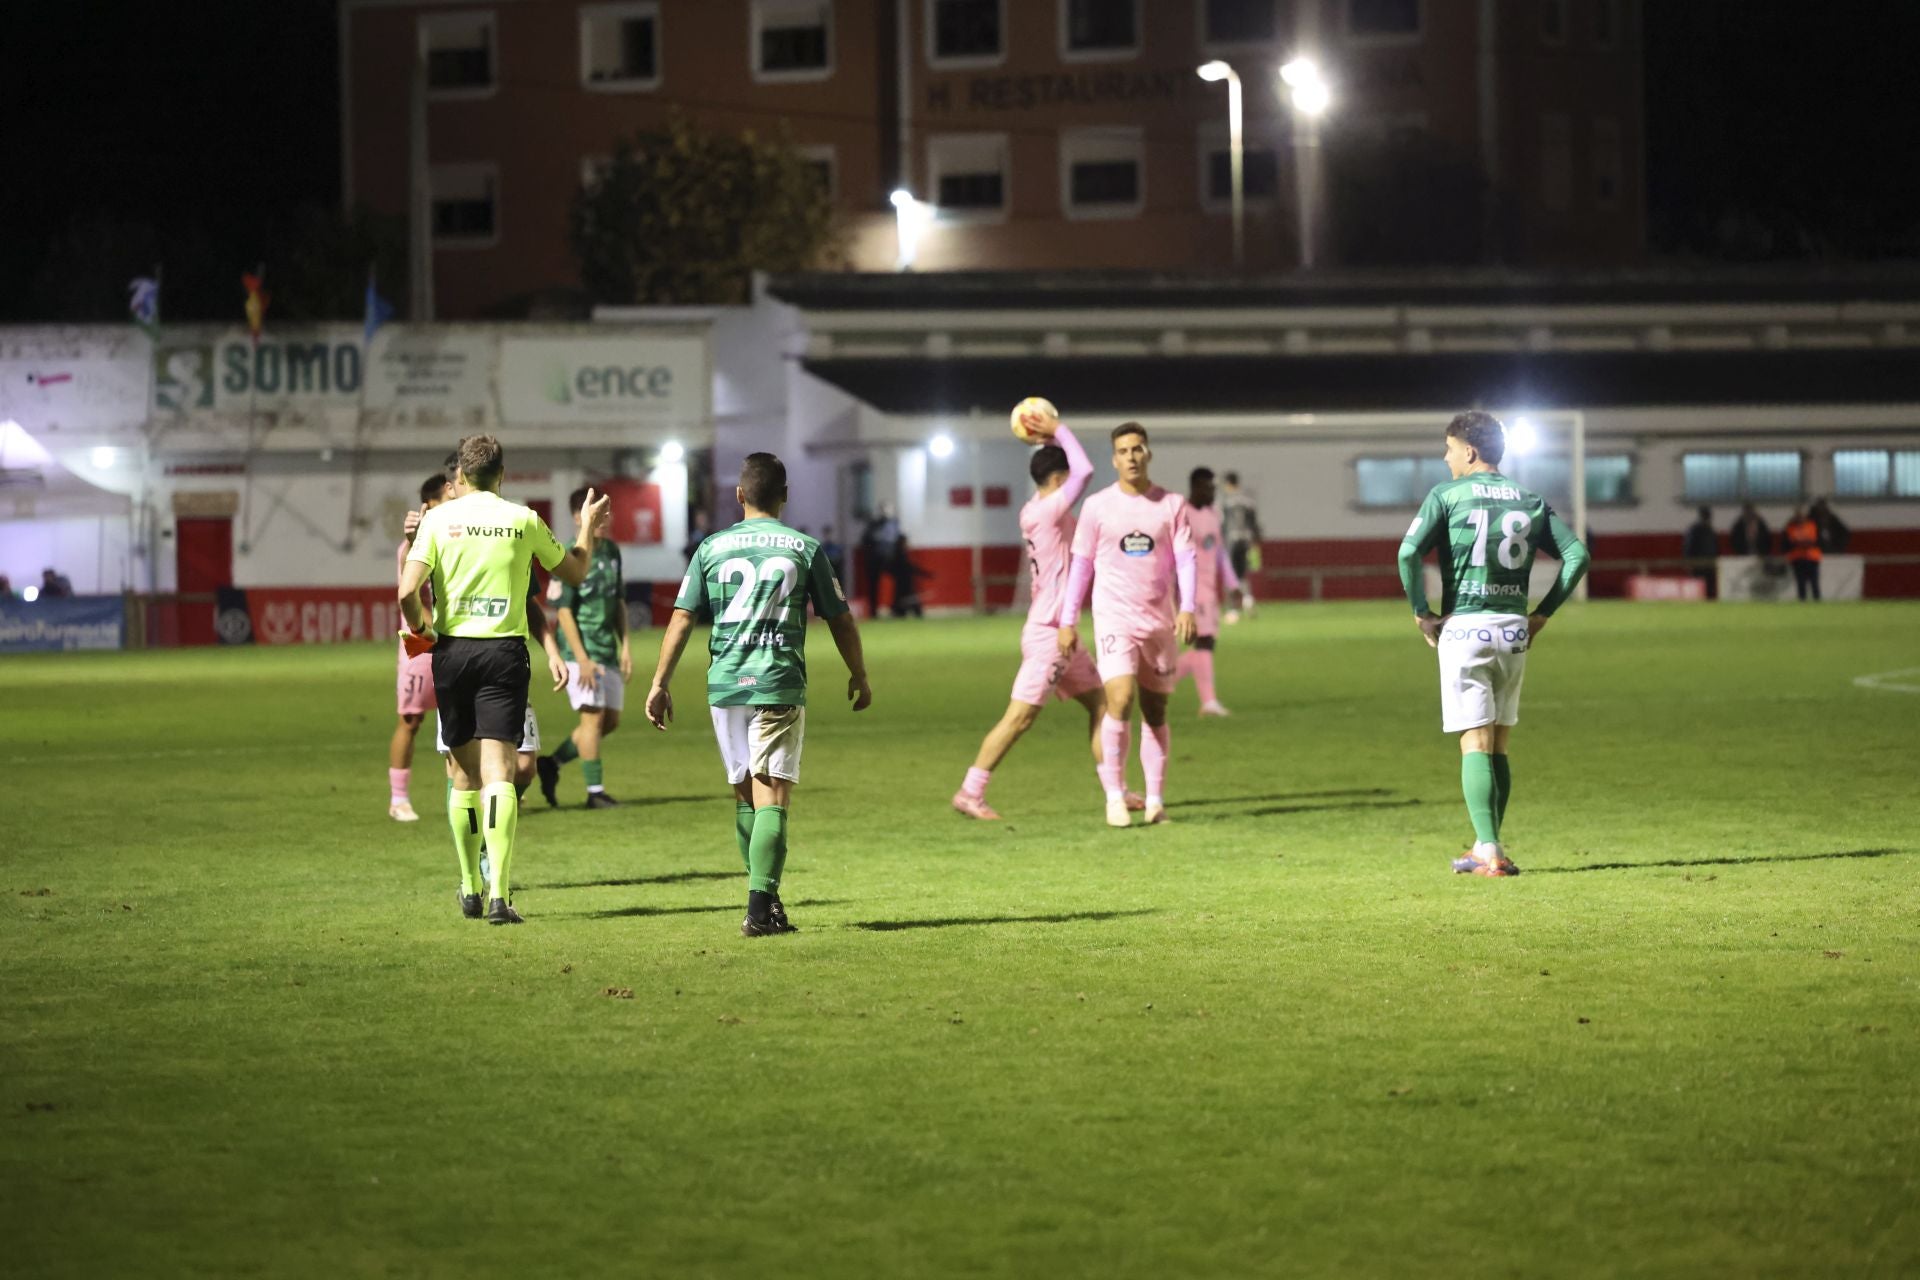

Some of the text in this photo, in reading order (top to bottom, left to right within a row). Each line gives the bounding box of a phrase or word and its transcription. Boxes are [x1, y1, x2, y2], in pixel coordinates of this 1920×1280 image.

[223, 342, 361, 394] SOMO
[575, 365, 674, 398] ence
[1472, 484, 1521, 500] RUBÉN
[466, 526, 523, 539] WÜRTH
[757, 534, 805, 551] OTERO
[1467, 509, 1531, 570] 18
[718, 556, 798, 623] 22
[302, 602, 363, 643] COPA
[1100, 634, 1117, 656] 12
[405, 674, 423, 693] 31
